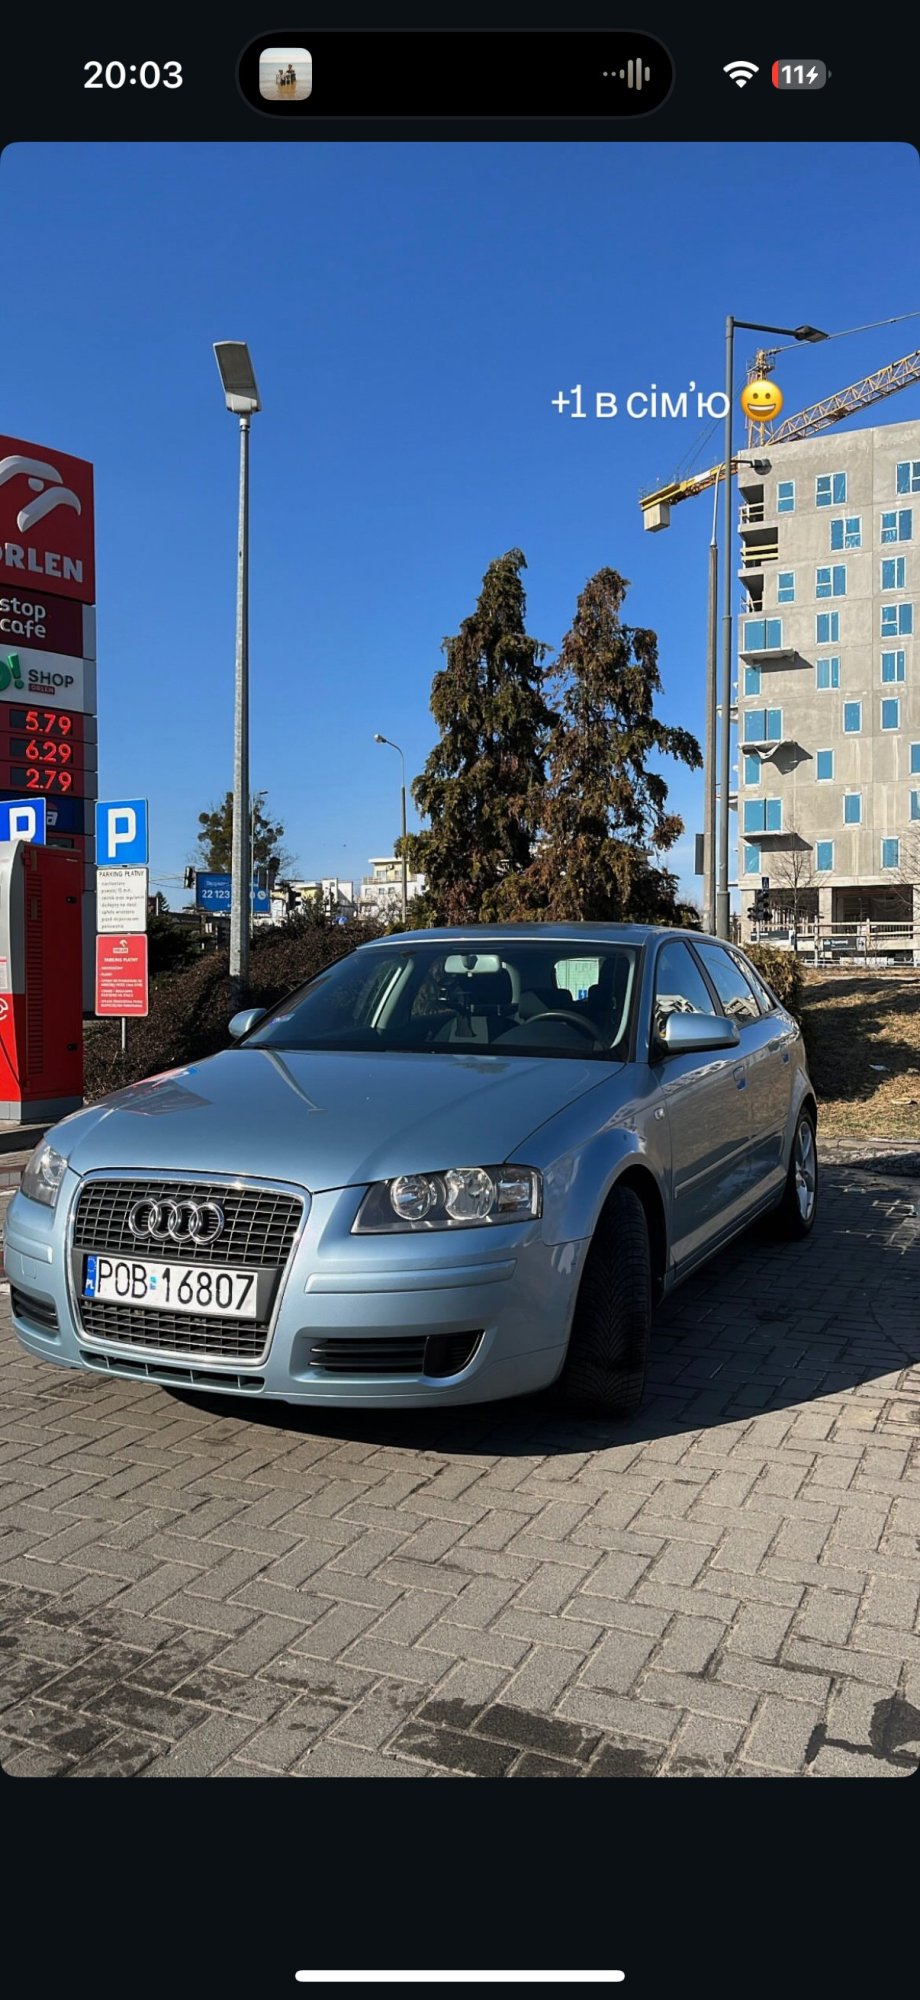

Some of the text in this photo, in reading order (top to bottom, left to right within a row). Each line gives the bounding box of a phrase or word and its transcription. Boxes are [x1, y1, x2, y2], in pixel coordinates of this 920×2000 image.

[0, 542, 83, 583] RLEN
[0, 597, 46, 622] stop
[0, 618, 46, 638] cafe
[28, 669, 74, 688] SHOP
[26, 711, 71, 735] 5.79
[26, 740, 71, 763] 6.29
[26, 768, 71, 791] 2.79
[107, 807, 136, 858] P
[201, 889, 230, 899] 22 123
[97, 1259, 254, 1309] POB 16807
